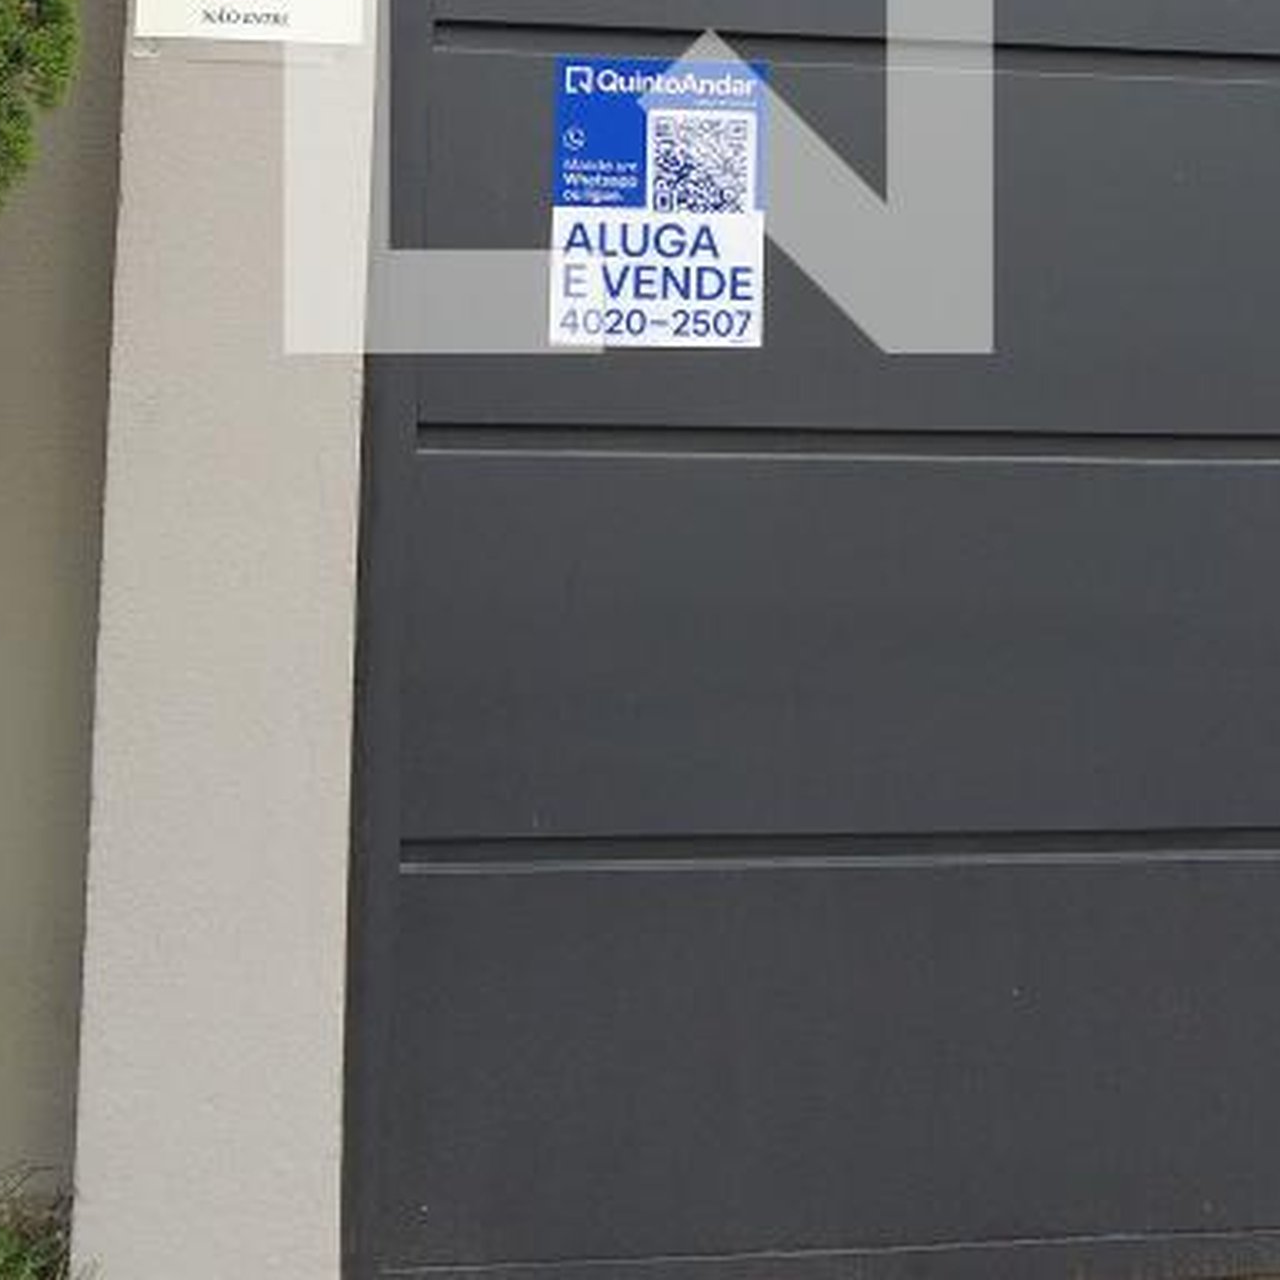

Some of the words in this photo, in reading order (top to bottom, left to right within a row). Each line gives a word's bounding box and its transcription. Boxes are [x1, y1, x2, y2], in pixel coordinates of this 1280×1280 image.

[595, 68, 757, 96] QuintoAndar
[563, 222, 720, 259] ALUGA
[563, 263, 587, 299] E
[602, 265, 754, 302] VENDE
[559, 308, 752, 338] 4020-2507
